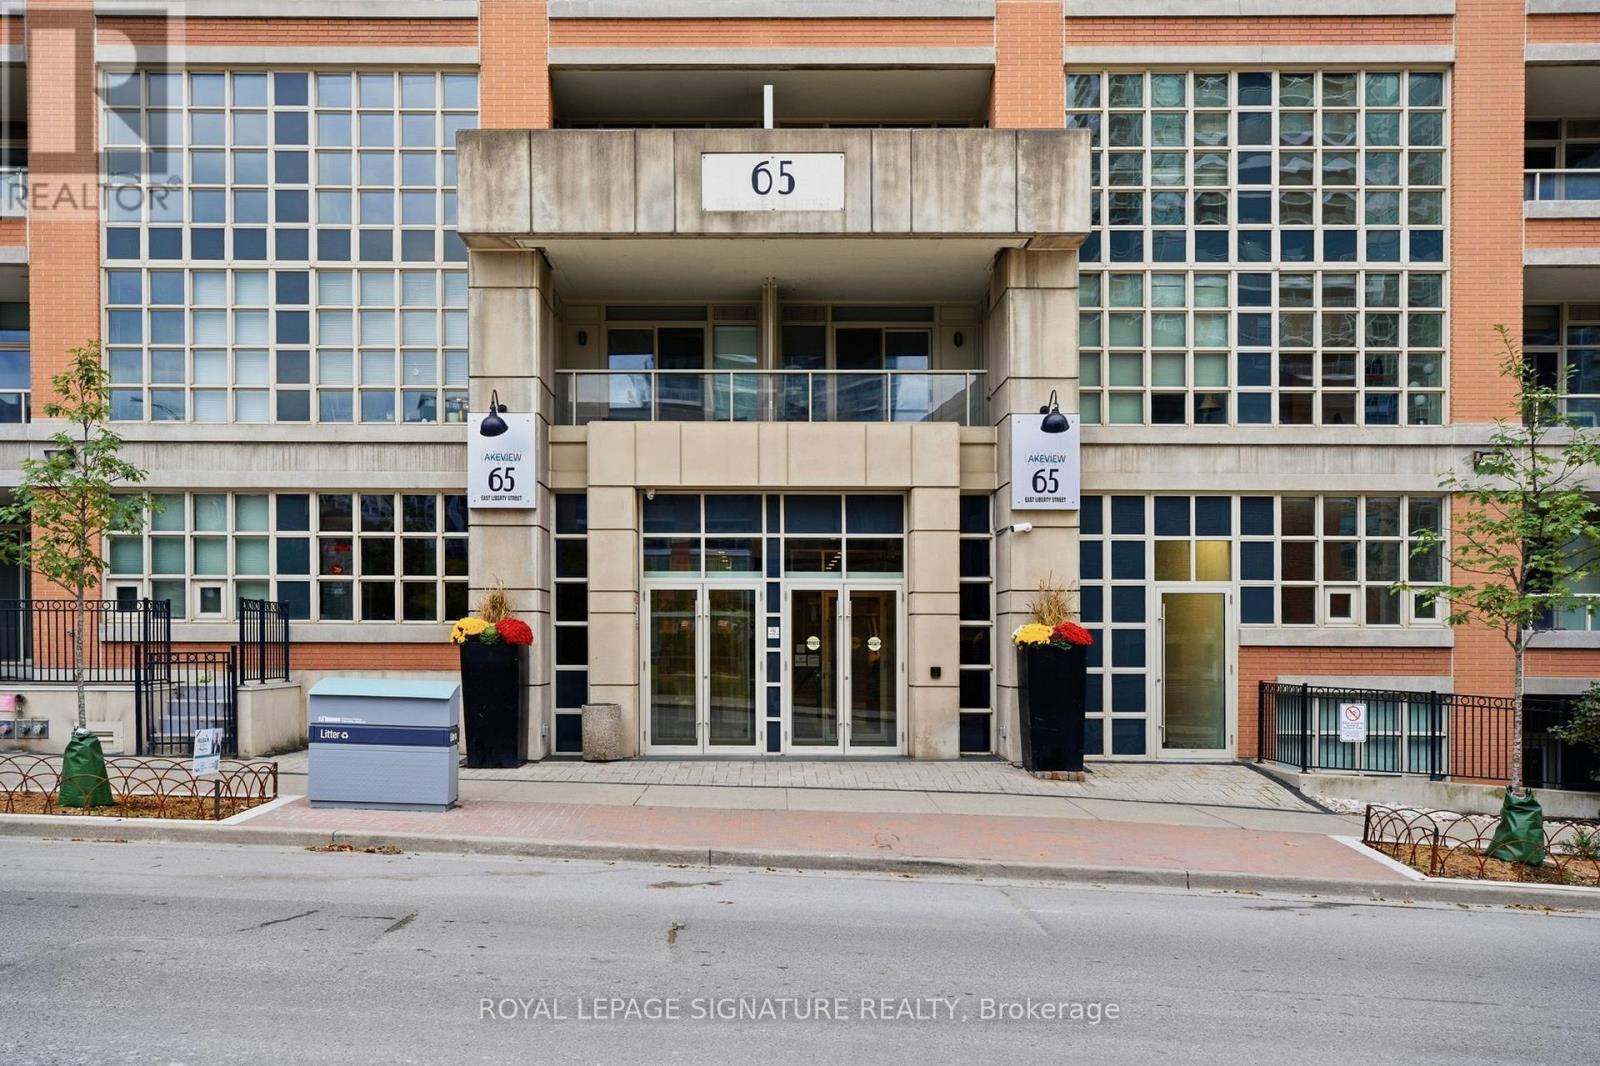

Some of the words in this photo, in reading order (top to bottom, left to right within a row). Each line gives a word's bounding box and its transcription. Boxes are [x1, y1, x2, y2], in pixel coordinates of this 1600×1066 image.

[751, 160, 796, 195] 65
[481, 453, 522, 462] AKEVIEW
[1025, 454, 1067, 463] AKEVIEW
[488, 466, 515, 492] 65
[1032, 468, 1059, 494] 65
[320, 728, 340, 739] Litter
